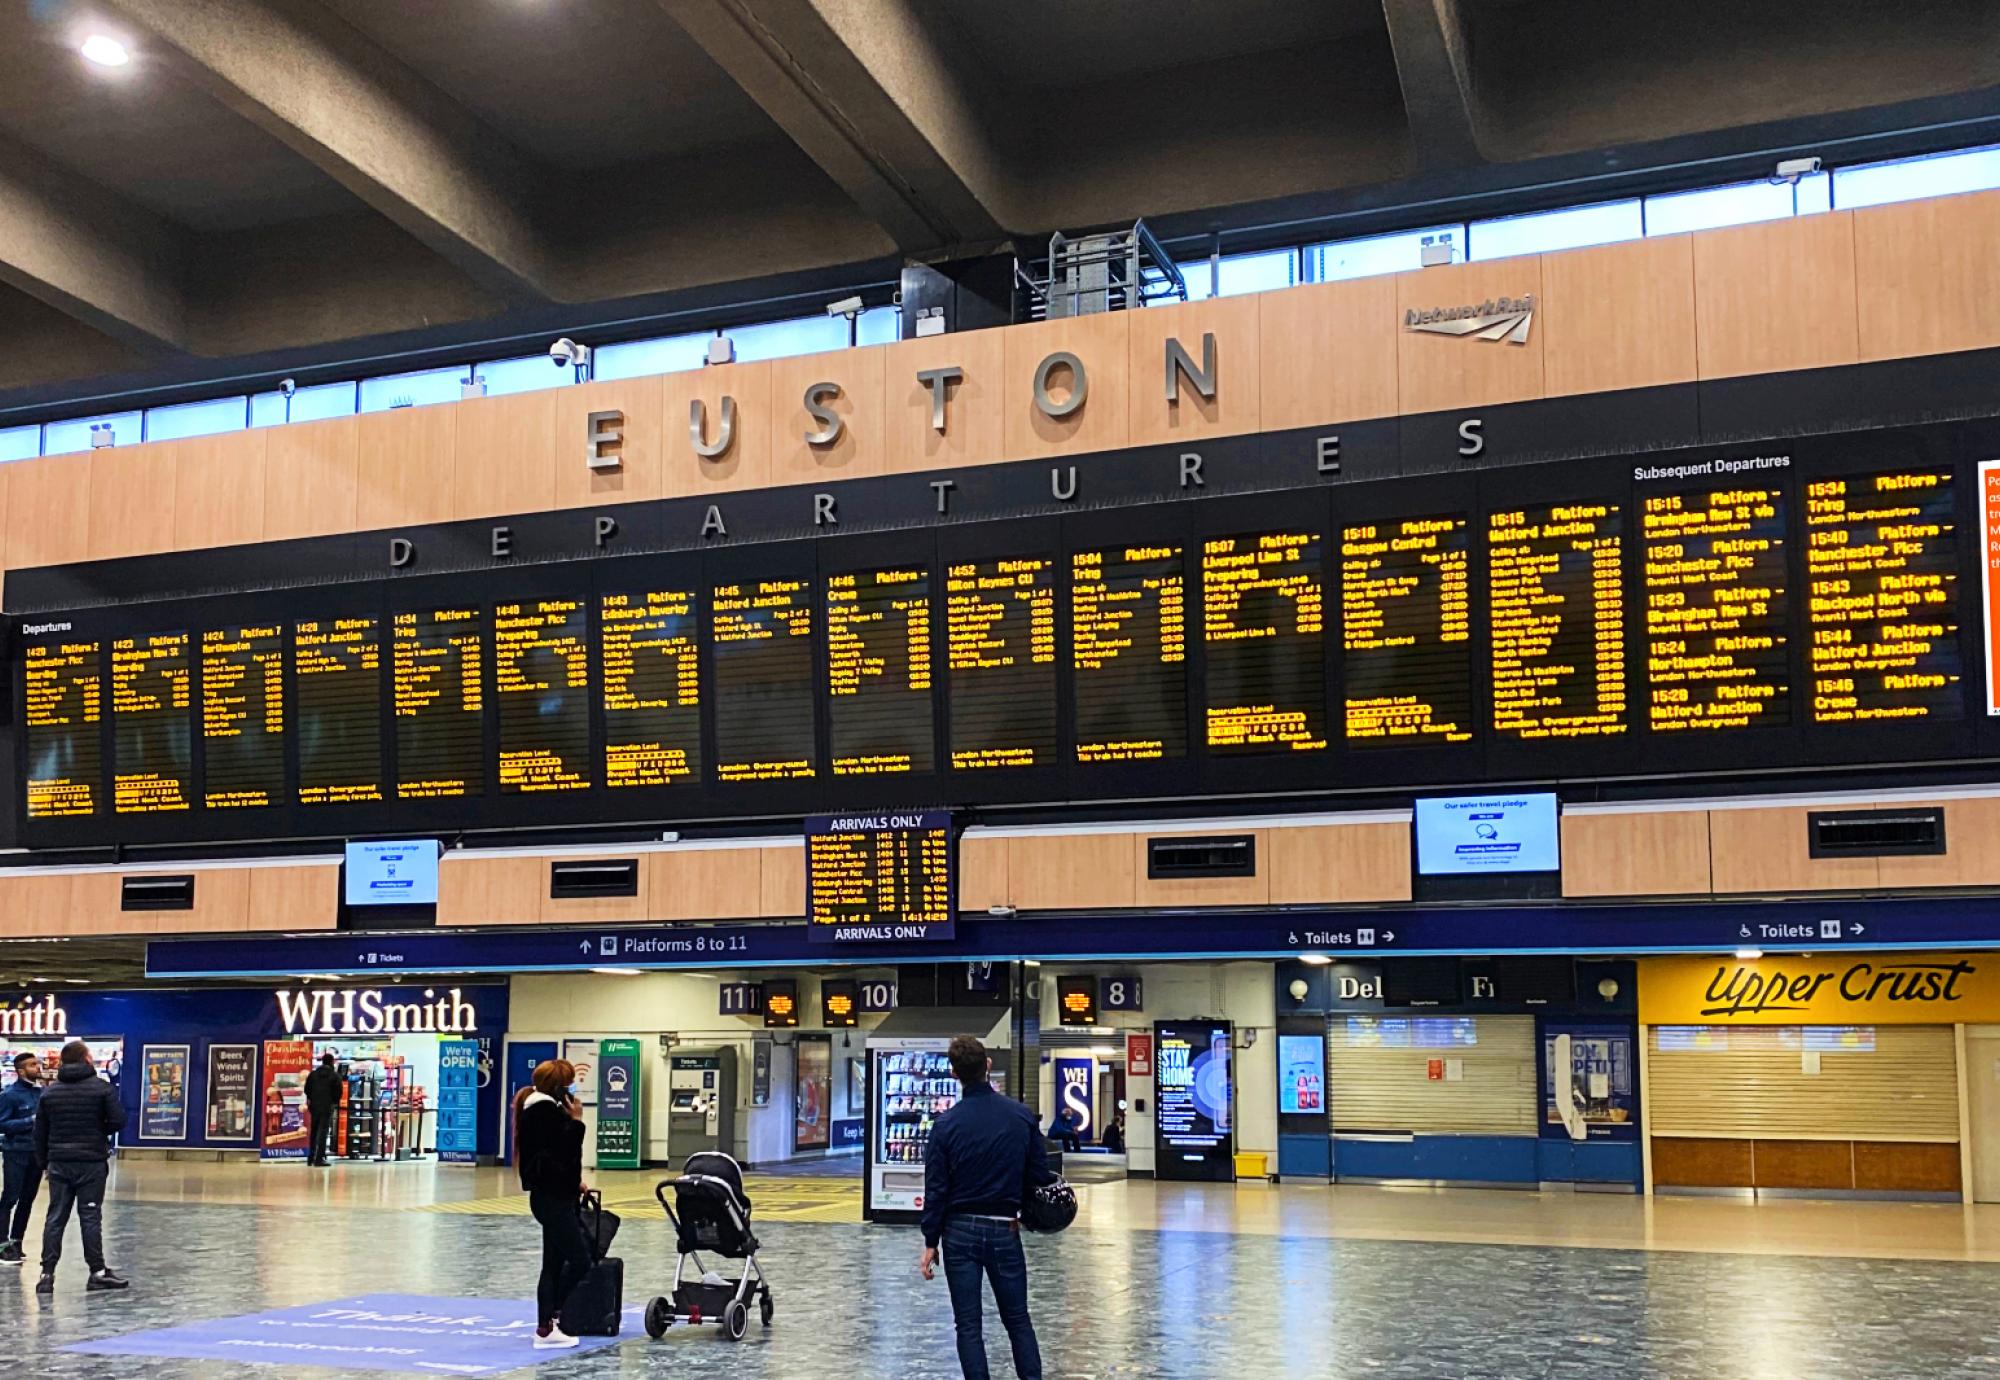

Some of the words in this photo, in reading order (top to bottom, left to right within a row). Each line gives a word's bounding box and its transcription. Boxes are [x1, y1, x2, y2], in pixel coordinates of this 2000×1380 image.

[587, 332, 1216, 468] EUSTON
[1635, 462, 1711, 480] Subsequent
[1715, 456, 1790, 473] Departures
[390, 419, 1484, 567] DEPARTURES
[1809, 482, 1845, 496] 15:34
[1877, 475, 1937, 491] Platform
[1646, 497, 1681, 511] 15:15
[1710, 491, 1767, 505] Platform
[1808, 499, 1845, 512] Tring
[1491, 513, 1524, 526] 15:15
[1552, 507, 1605, 521] Platform
[1644, 512, 1706, 527] Birmingham
[1710, 509, 1732, 521] New
[1736, 507, 1750, 518] St
[1754, 505, 1774, 516] via
[1344, 527, 1376, 540] 15:10
[1402, 521, 1452, 535] Platform
[1490, 527, 1538, 542] Watford
[1542, 523, 1594, 538] Junction
[1810, 531, 1848, 545] 15:40
[1878, 525, 1939, 540] Platform
[1205, 541, 1235, 553] 15:07
[1260, 536, 1308, 549] Platform
[1342, 543, 1387, 556] Glasgow
[1391, 536, 1436, 550] Central
[1648, 545, 1683, 559] 15:20
[1713, 540, 1769, 554] Platform
[1810, 545, 1888, 561] Manchester
[1894, 542, 1923, 554] Picc
[1073, 554, 1101, 566] 15:04
[1126, 549, 1171, 561] Platform
[1204, 553, 1254, 568] Liverpool
[1258, 551, 1282, 563] Lime
[1286, 549, 1299, 561] St
[1646, 559, 1721, 574] Manchester
[1727, 556, 1753, 568] Picc
[949, 566, 976, 577] 14:52
[998, 561, 1040, 573] Platform
[1073, 569, 1101, 580] Tring
[1204, 569, 1259, 582] Preparing
[877, 573, 917, 584] Platform
[948, 579, 974, 591] Milton
[978, 578, 1014, 588] Keynes
[1812, 580, 1850, 594] 15:43
[1881, 575, 1941, 589] Platform
[714, 587, 739, 597] 14:45
[759, 583, 799, 593] Platform
[828, 591, 857, 601] Crewe
[1650, 593, 1684, 607] 15:23
[1714, 588, 1770, 602] Platform
[539, 602, 575, 612] Platform
[603, 596, 627, 606] 14:43
[648, 593, 685, 603] Platform
[714, 598, 749, 610] Watford
[752, 596, 790, 607] Junction
[1811, 594, 1873, 610] Blackpool
[1878, 591, 1920, 605] North
[1925, 589, 1946, 601] via
[395, 615, 416, 624] 14:34
[435, 611, 470, 621] Platform
[602, 608, 646, 620] Edinburgh
[649, 605, 688, 616] Waverley
[1648, 608, 1716, 622] Birmingham
[1722, 605, 1747, 617] New
[1752, 603, 1767, 615] St
[23, 622, 71, 635] Departures
[335, 620, 369, 629] Platform
[496, 617, 544, 629] Manchester
[548, 615, 566, 624] Picc
[150, 636, 180, 645] Platform
[182, 635, 188, 643] 5
[203, 632, 224, 641] 14:24
[241, 628, 273, 638] Platform
[276, 626, 281, 635] 7
[296, 634, 326, 645] Watford
[330, 632, 362, 643] Junction
[394, 628, 416, 637] Tring
[496, 631, 538, 641] Preparing
[1815, 630, 1851, 644] 15:44
[1882, 625, 1943, 640] Platform
[61, 645, 91, 654] Platform
[94, 643, 99, 651] 2
[203, 643, 250, 653] Northampton
[1651, 641, 1686, 655] 15:24
[1716, 636, 1772, 650] Platform
[1813, 644, 1867, 660] Watford
[1872, 641, 1930, 656] Junction
[26, 659, 65, 668] Manchester
[112, 651, 150, 661] Birmingham
[1649, 655, 1733, 670] Northampton
[1885, 675, 1945, 689] Platform
[1718, 686, 1774, 698] Platform
[1651, 704, 1702, 718] Watford
[1708, 701, 1762, 715] Junction
[1815, 697, 1857, 709] Crewe
[831, 818, 887, 831] ARRIVALS
[891, 815, 923, 828] ONLY
[835, 928, 891, 940] ARRIVALS
[895, 926, 926, 938] ONLY
[1305, 932, 1351, 944] Toilets
[1759, 923, 1814, 938] Toilets
[625, 938, 693, 952] Platforms
[696, 937, 705, 951] 8
[710, 936, 725, 951] to
[729, 936, 747, 950] 11
[379, 954, 403, 962] Tickets
[1109, 982, 1125, 1005] 8
[1339, 976, 1383, 998] Del
[1701, 967, 1834, 1017] Upper
[1840, 960, 1976, 1001] Crust
[723, 987, 743, 1008] 11
[862, 985, 888, 1007] 10
[276, 989, 477, 1034] WHSmith
[445, 1046, 472, 1056] We're
[1162, 1049, 1189, 1067] STAY
[442, 1057, 475, 1068] OPEN
[220, 1074, 244, 1083] Spirits
[1063, 1068, 1088, 1082] WH
[1163, 1067, 1195, 1086] HOME
[1064, 1082, 1089, 1132] S
[843, 1127, 858, 1139] Keep
